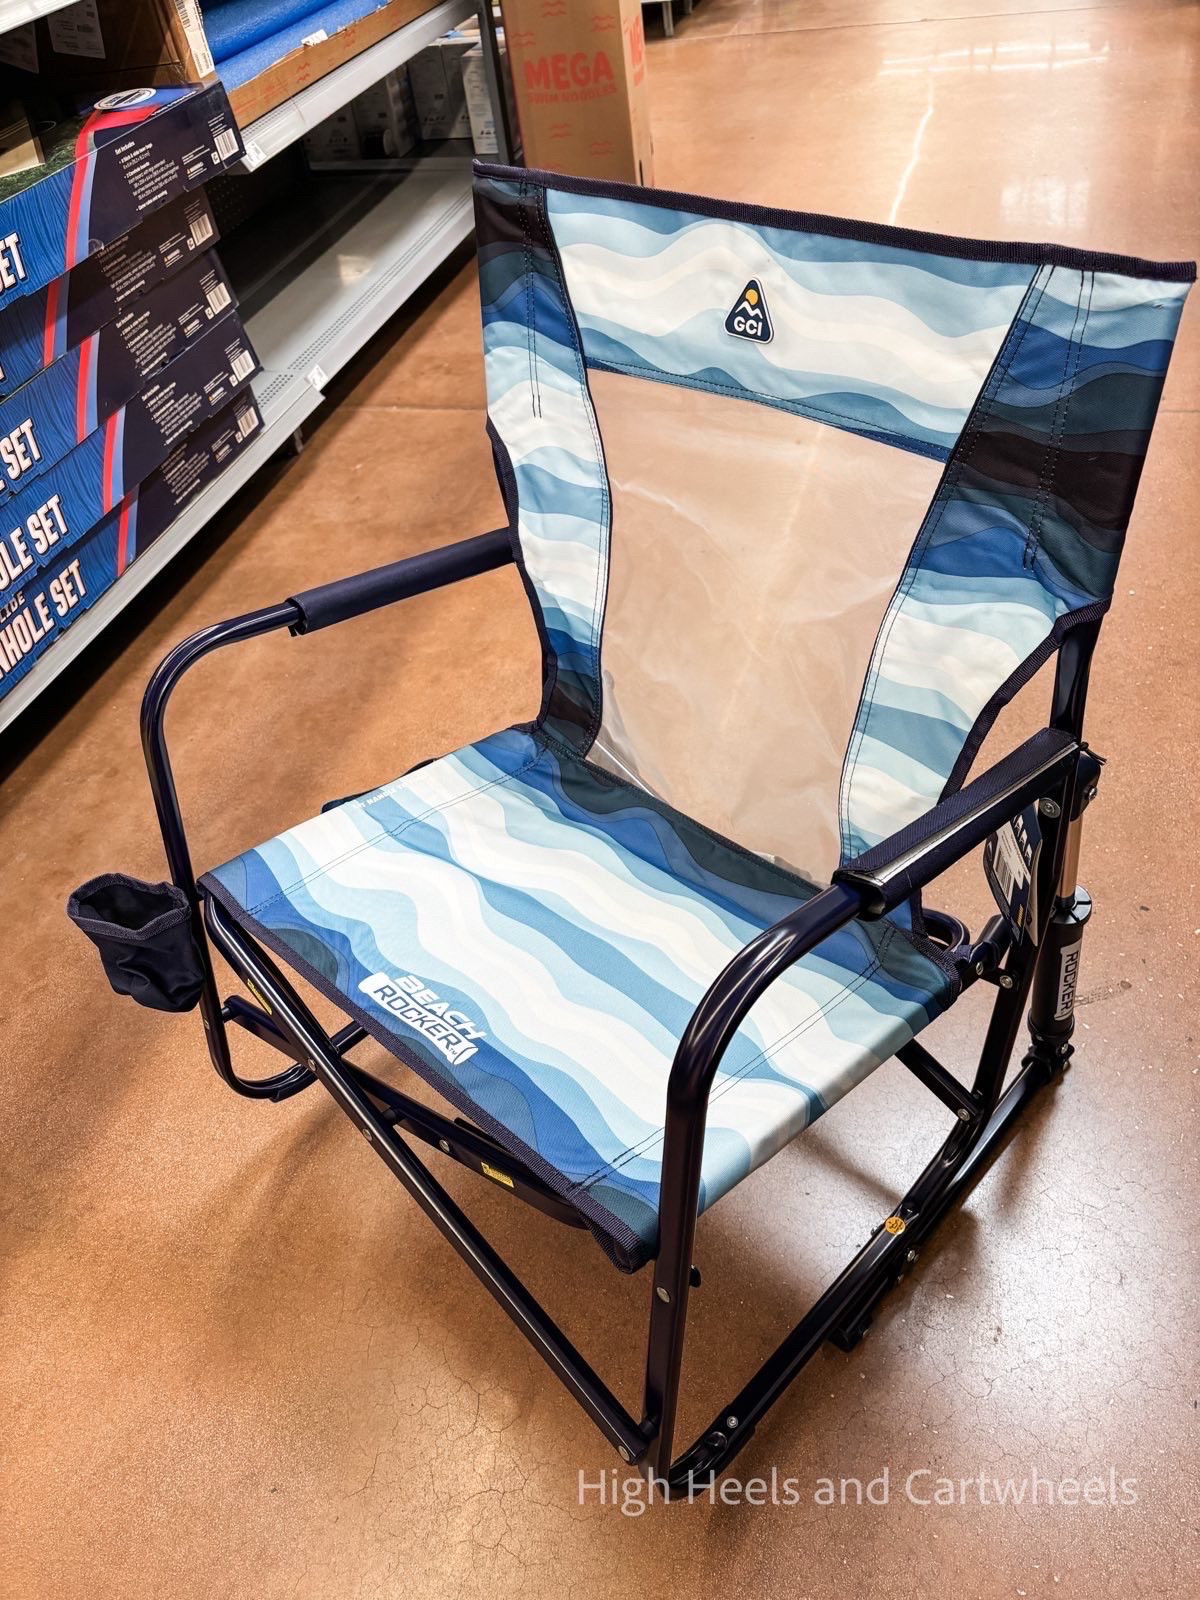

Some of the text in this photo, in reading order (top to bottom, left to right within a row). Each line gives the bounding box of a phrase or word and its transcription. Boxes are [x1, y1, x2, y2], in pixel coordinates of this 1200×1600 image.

[523, 51, 614, 90] MEGA
[734, 316, 763, 337] GCI
[0, 418, 41, 480] SET
[27, 494, 68, 554] SET
[49, 558, 86, 617] SET
[393, 974, 489, 1040] BEACH
[1060, 951, 1080, 1012] ROCKER
[373, 984, 463, 1053] ROCKER
